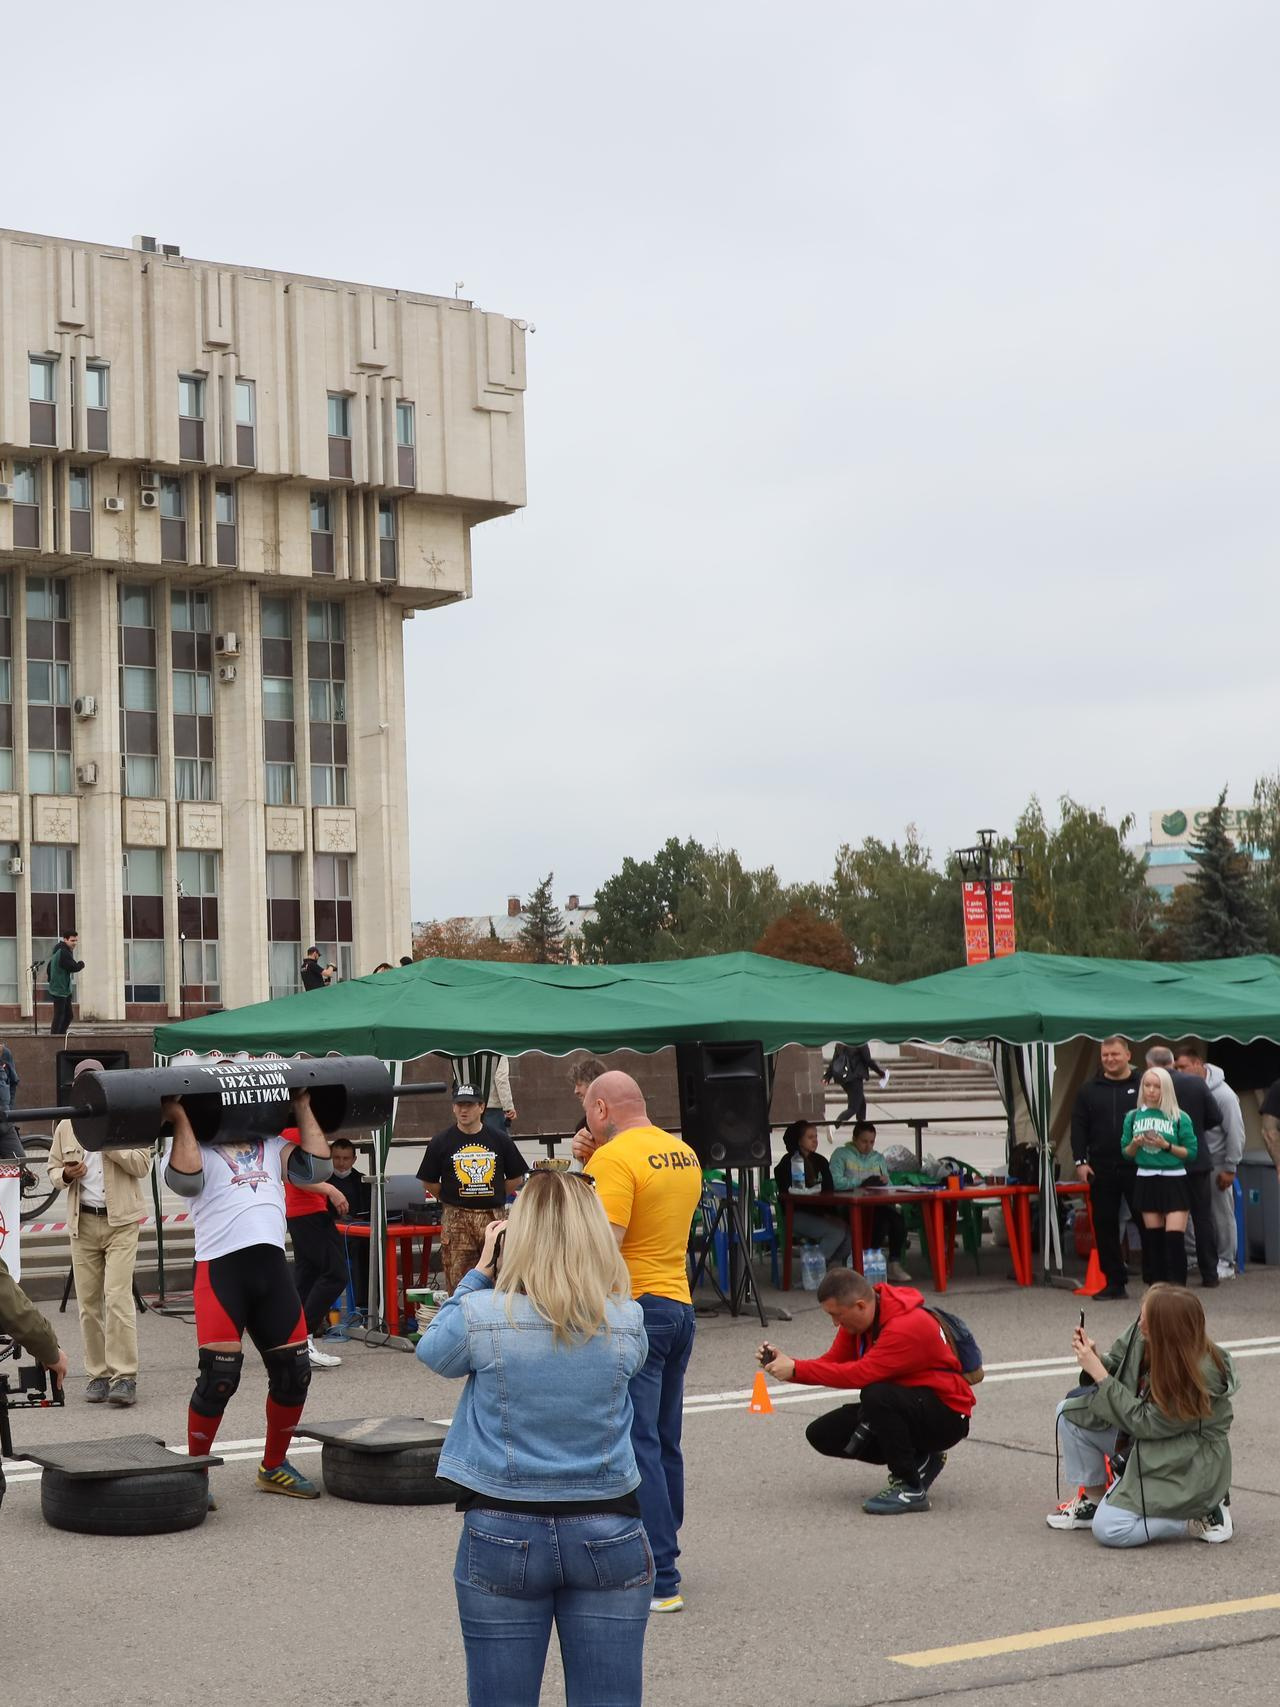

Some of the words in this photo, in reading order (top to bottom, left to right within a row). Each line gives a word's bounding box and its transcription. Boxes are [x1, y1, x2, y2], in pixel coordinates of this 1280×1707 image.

[221, 1087, 290, 1106] АТЛЕТИКИ
[1133, 1117, 1174, 1136] CALIFORNIA
[648, 1151, 699, 1170] СУДЬЯ
